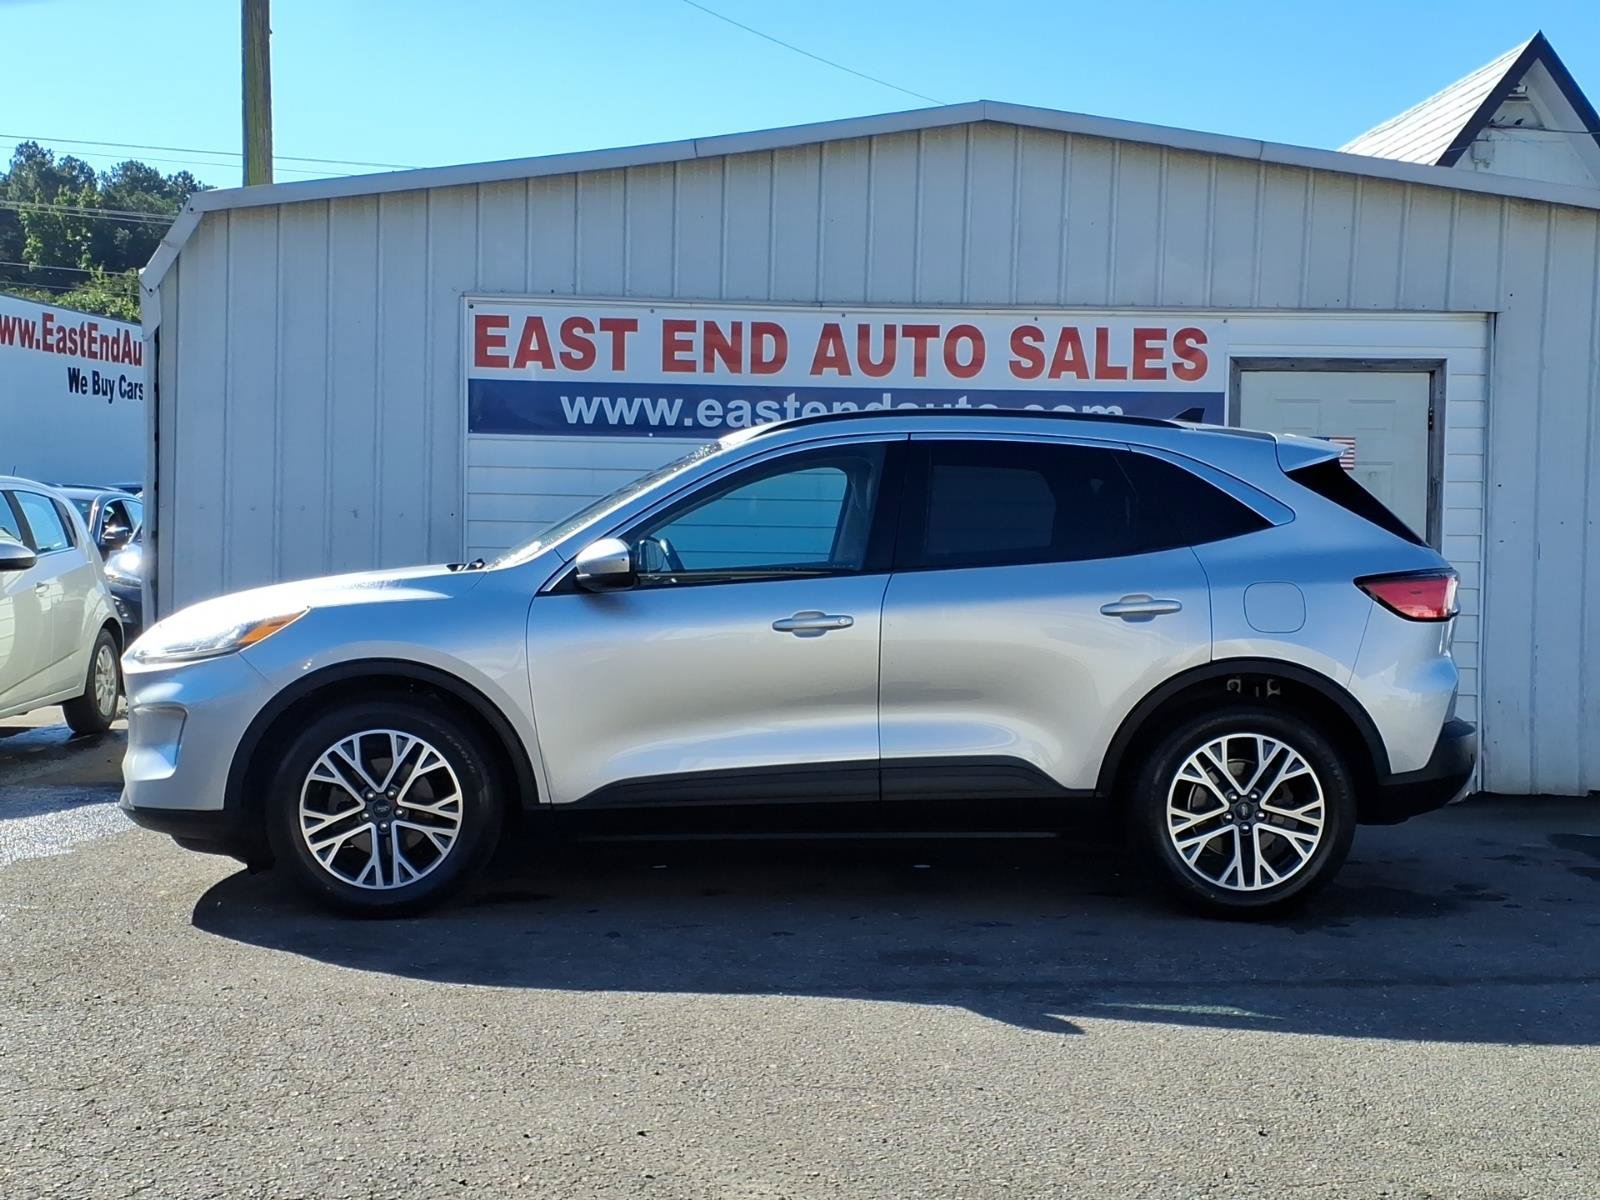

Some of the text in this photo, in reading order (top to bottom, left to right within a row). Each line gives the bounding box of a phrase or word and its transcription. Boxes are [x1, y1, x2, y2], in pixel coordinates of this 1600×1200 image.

[474, 314, 1209, 381] EAST END AUTO SALES
[67, 366, 143, 404] We Buy Cars
